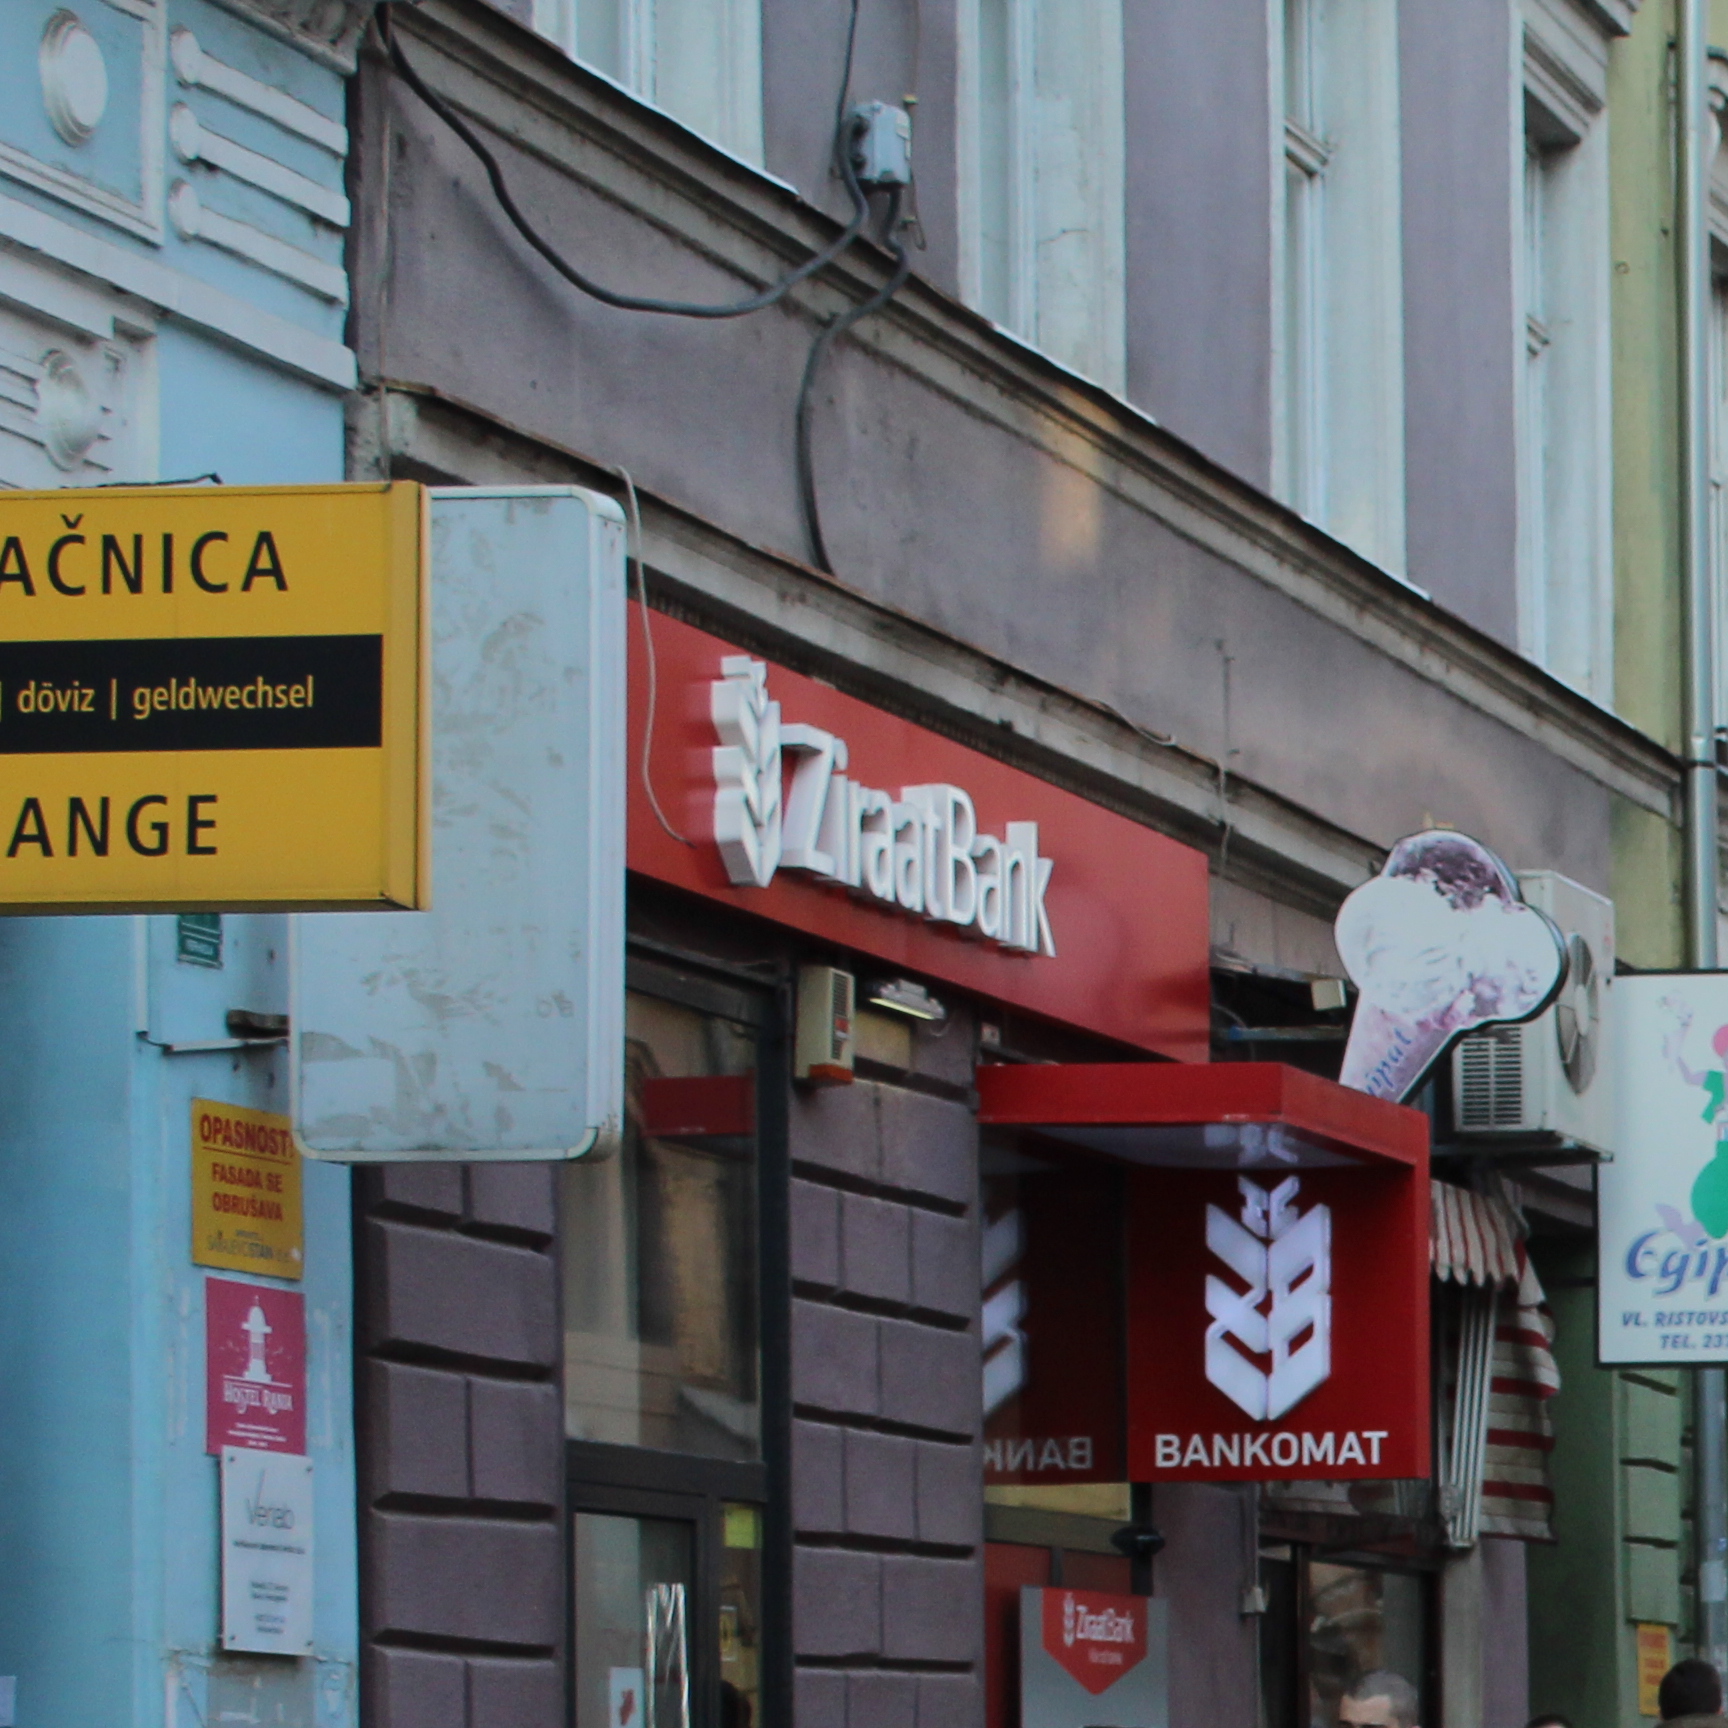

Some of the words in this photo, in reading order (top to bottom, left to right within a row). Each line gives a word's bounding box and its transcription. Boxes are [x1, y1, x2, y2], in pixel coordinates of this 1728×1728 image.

[16, 680, 96, 713] döviz
[132, 674, 315, 720] geldwechsel
[211, 1162, 263, 1189] FASADA
[266, 1171, 284, 1193] SE
[212, 1191, 284, 1222] OBRUŠAVA
[1622, 1311, 1648, 1327] VL.
[1660, 1333, 1697, 1349] TEL.
[1155, 1431, 1389, 1468] BANKOMAT
